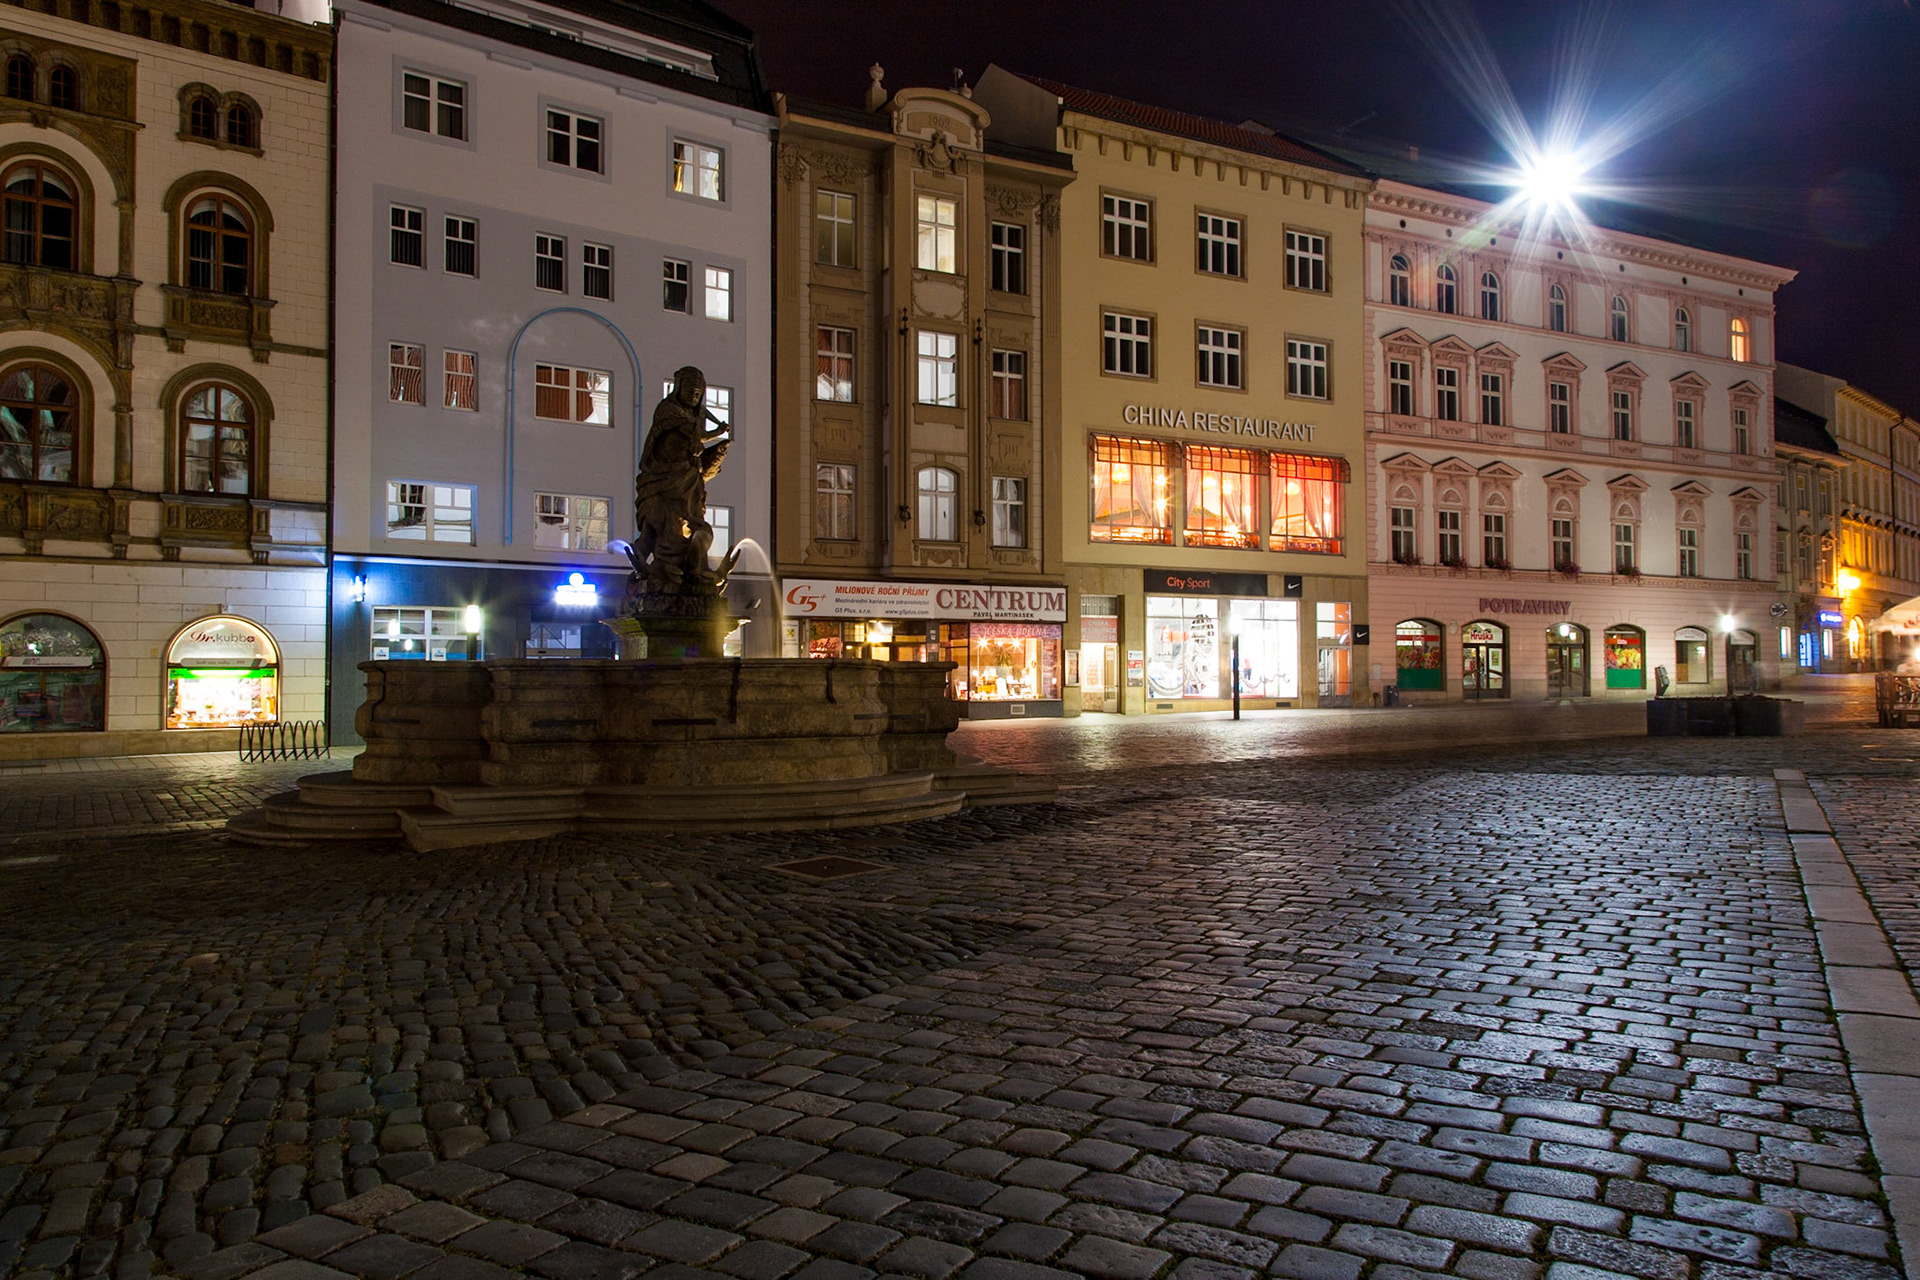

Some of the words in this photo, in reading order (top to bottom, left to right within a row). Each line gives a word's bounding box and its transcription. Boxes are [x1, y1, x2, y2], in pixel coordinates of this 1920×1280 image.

[1123, 405, 1188, 430] CHINA
[1193, 411, 1316, 442] RESTAURANT
[834, 584, 875, 595] MILIONOVÉ
[878, 585, 900, 596] ROČNÍ
[902, 585, 930, 596] PŘÍJMY
[1166, 576, 1186, 589] City
[1187, 577, 1211, 589] Sport
[935, 588, 1065, 612] CENTRUM
[1478, 597, 1572, 616] POTRAVINY
[1470, 630, 1494, 641] Hruška
